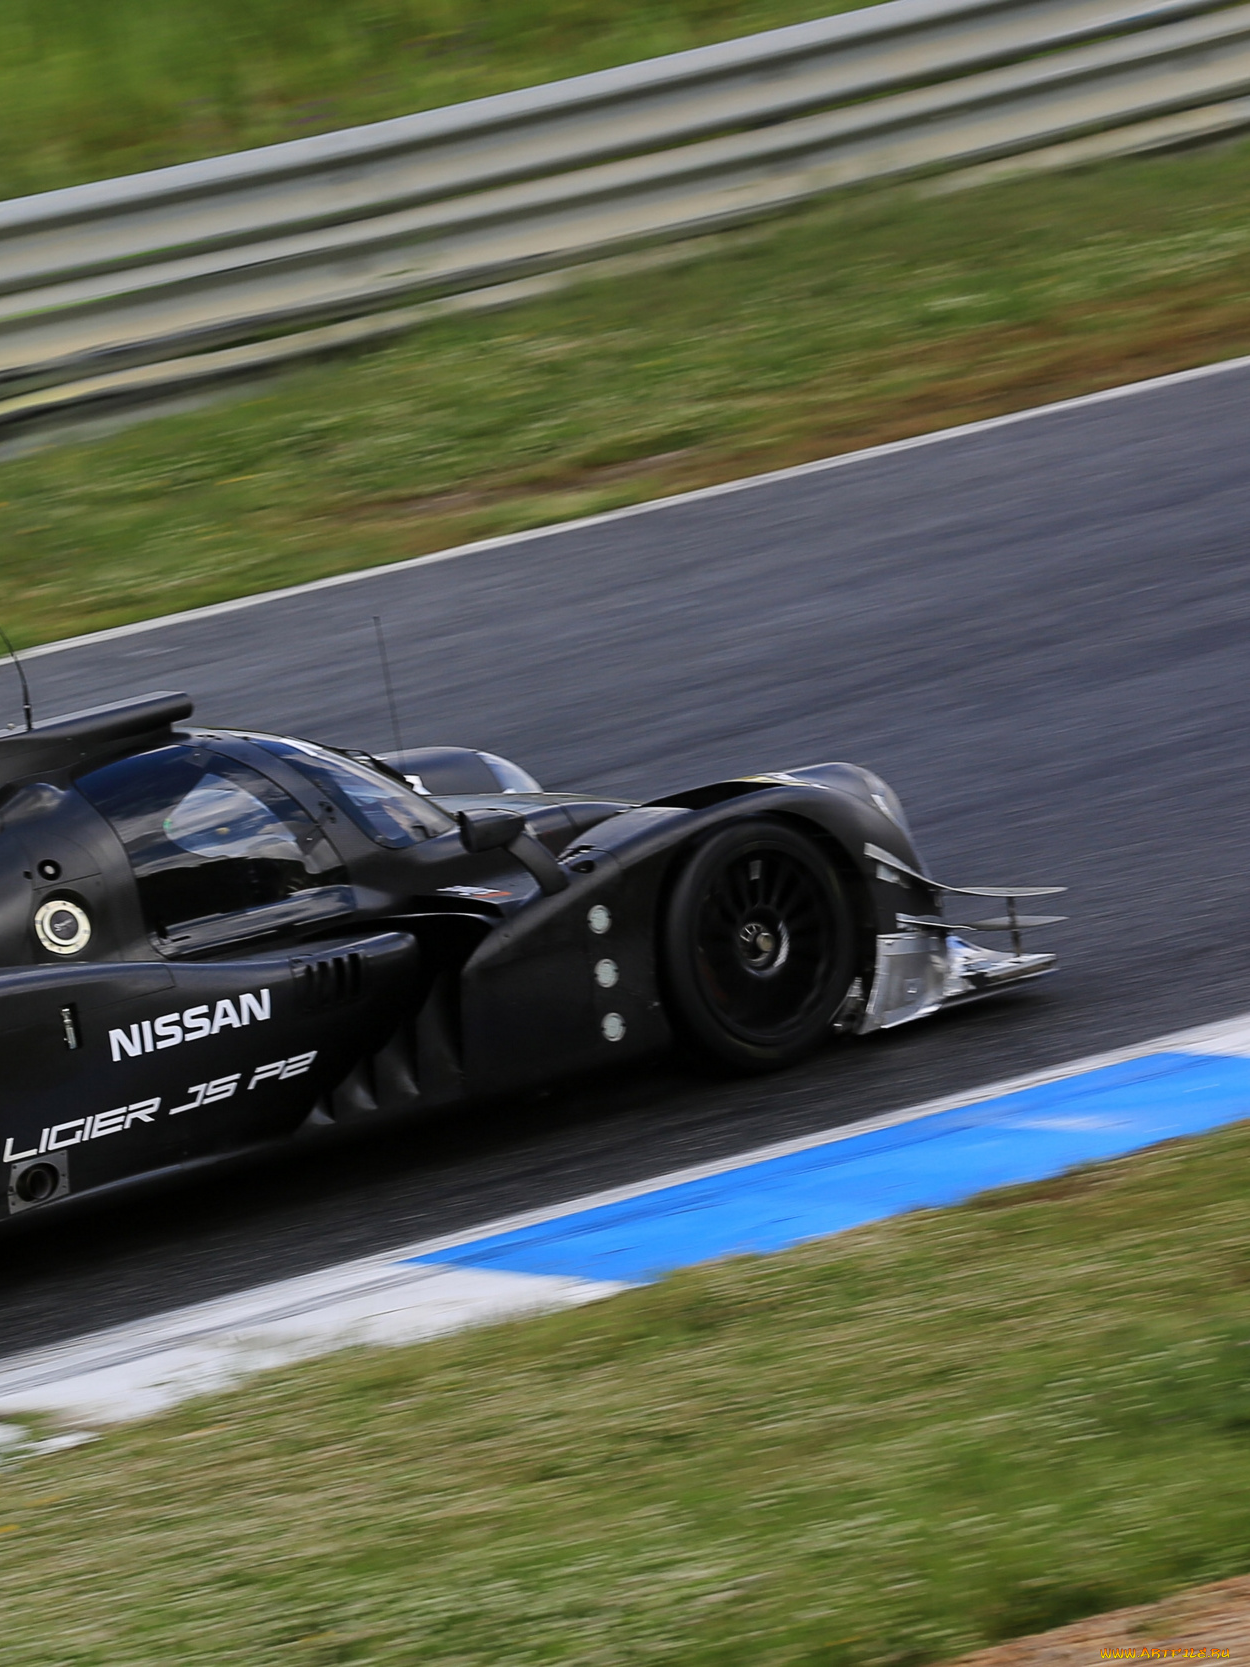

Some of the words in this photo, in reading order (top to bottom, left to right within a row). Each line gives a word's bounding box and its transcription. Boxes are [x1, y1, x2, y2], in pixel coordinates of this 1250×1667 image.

[108, 988, 271, 1062] NISSAN
[3, 1097, 161, 1163] LIGIER
[169, 1073, 241, 1115] JS
[247, 1050, 318, 1090] P2
